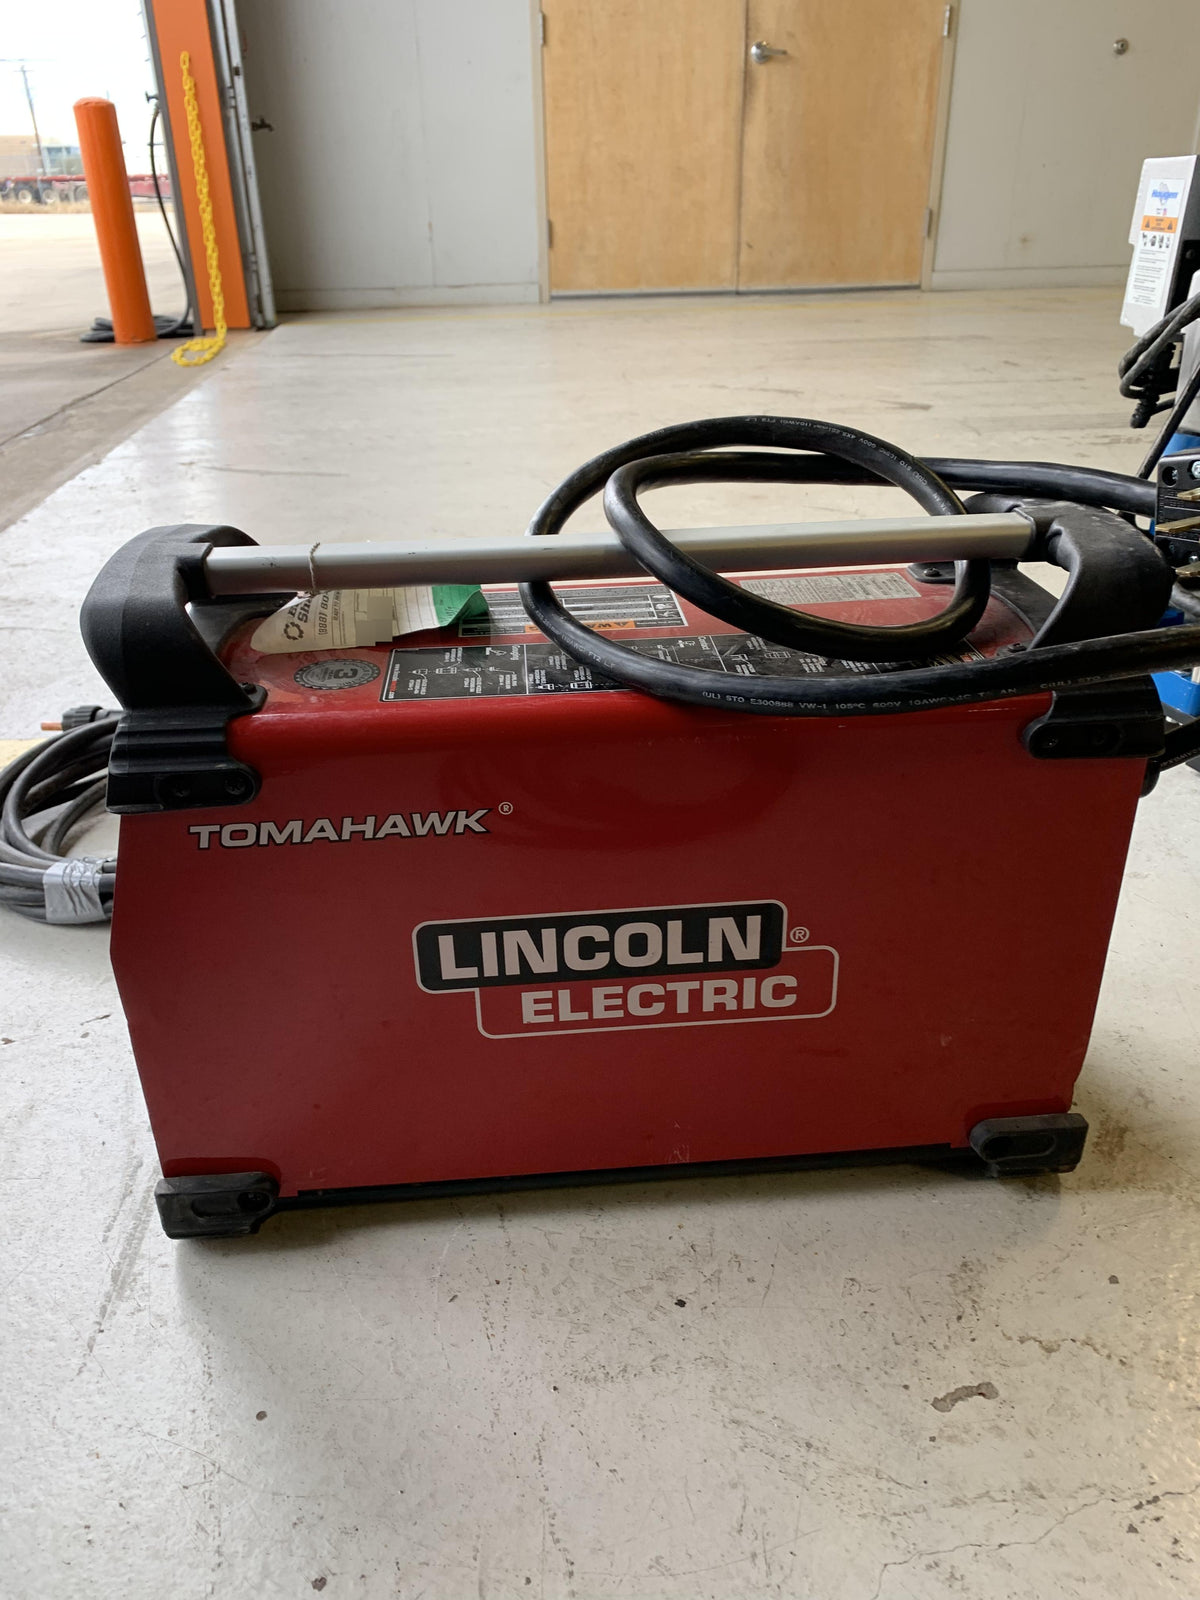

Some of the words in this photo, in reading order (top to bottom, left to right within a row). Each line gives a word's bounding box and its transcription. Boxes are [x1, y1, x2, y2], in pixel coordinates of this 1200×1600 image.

[702, 691, 721, 700] (UL)
[725, 694, 745, 703] STO
[799, 701, 827, 710] VW-1
[189, 808, 491, 849] TOMAHAWK
[438, 914, 762, 981] LINCOLN
[521, 975, 798, 1025] ELECTRIC
